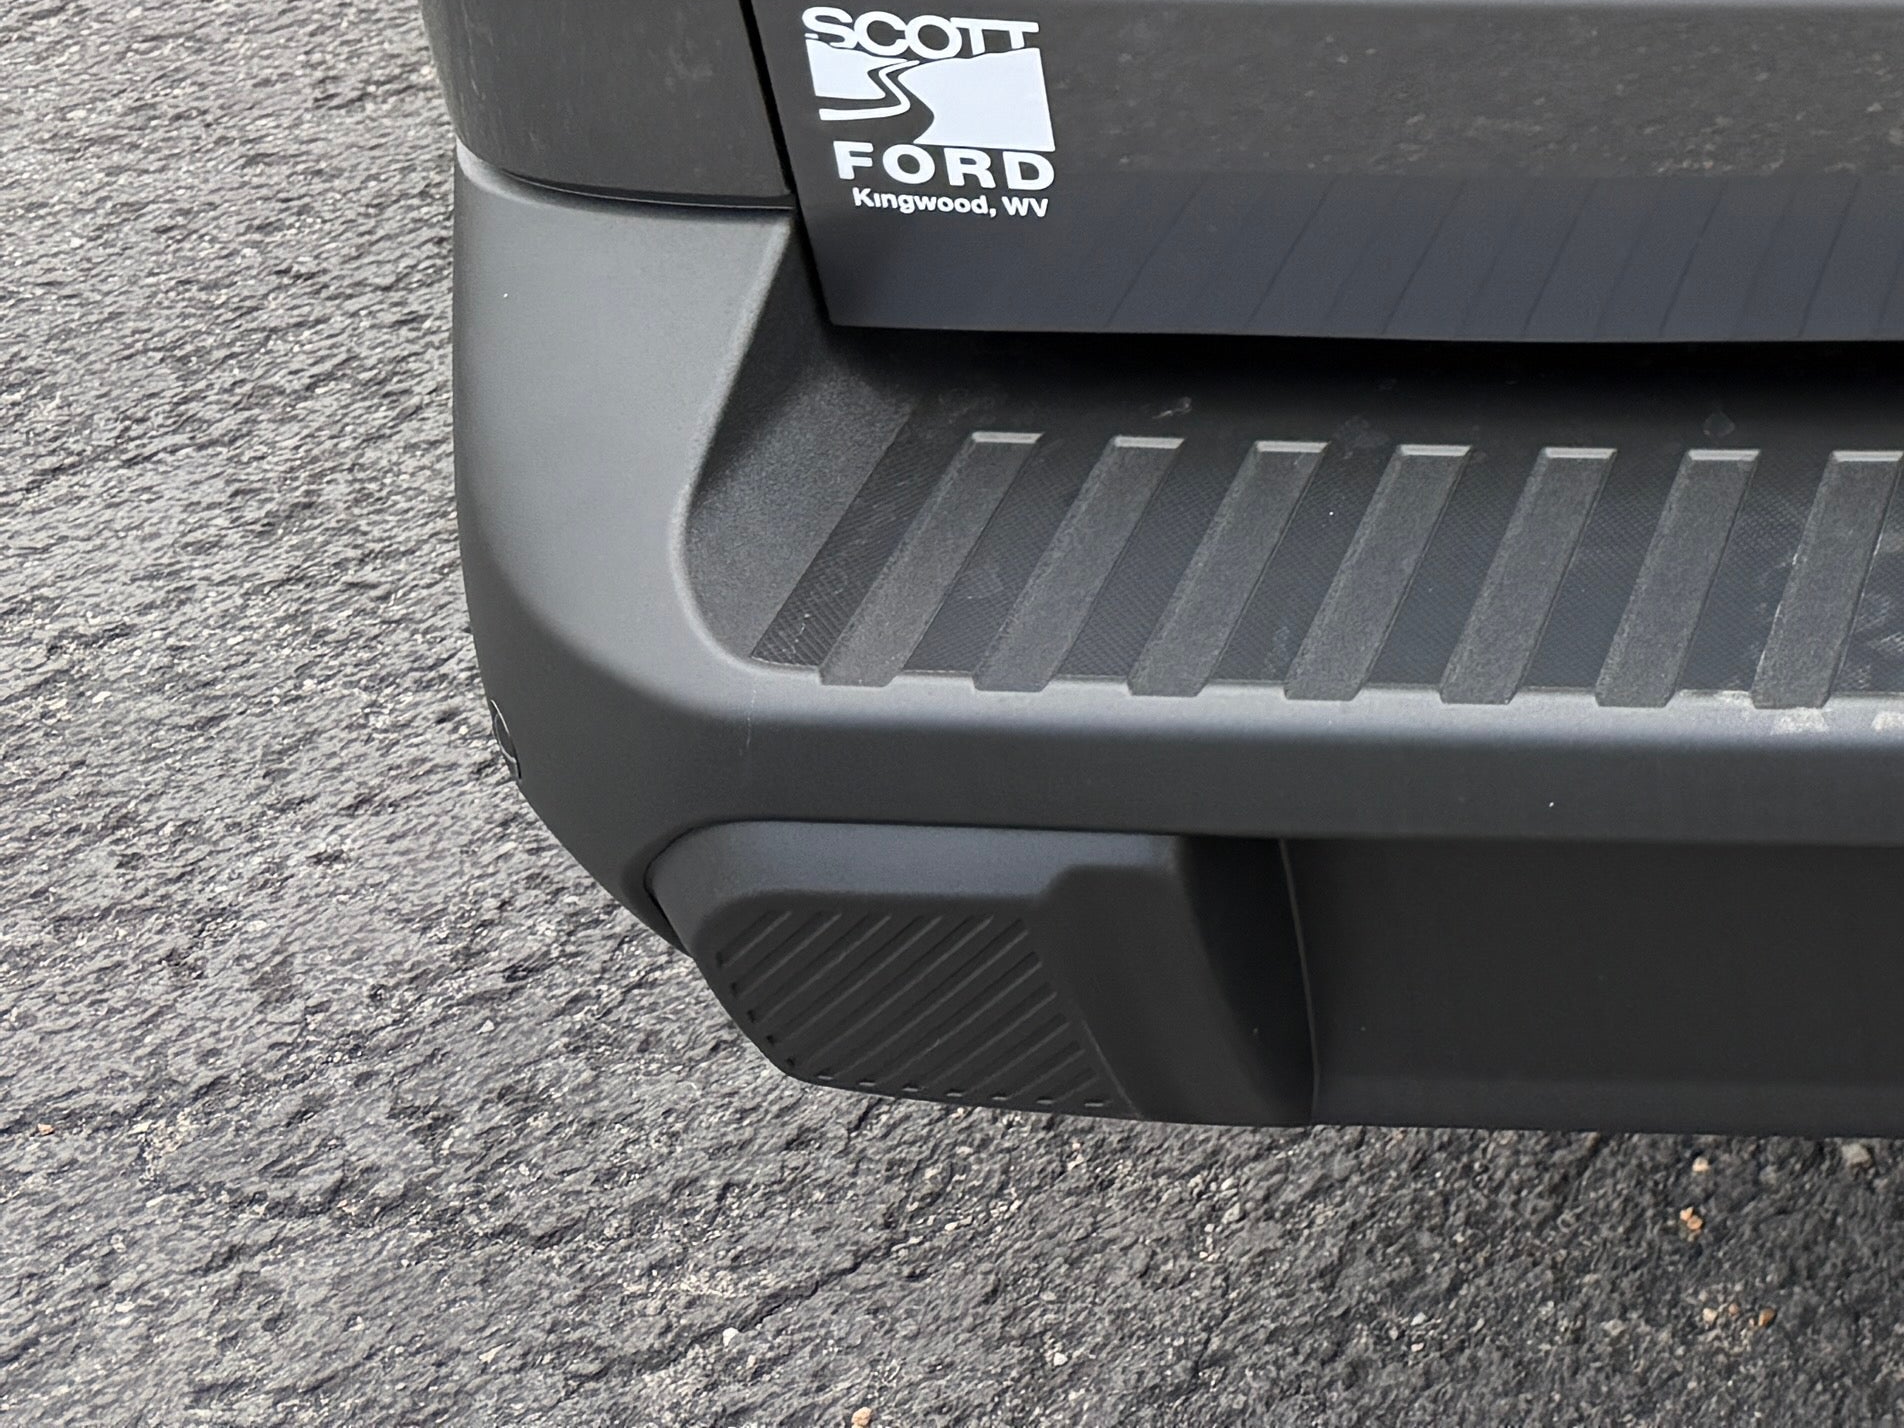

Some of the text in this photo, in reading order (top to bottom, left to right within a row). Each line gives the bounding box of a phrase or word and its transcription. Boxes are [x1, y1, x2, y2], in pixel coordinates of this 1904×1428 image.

[802, 6, 1040, 60] SCOTT
[832, 140, 1056, 191] FORD
[851, 186, 1049, 218] Kingwood, WV
